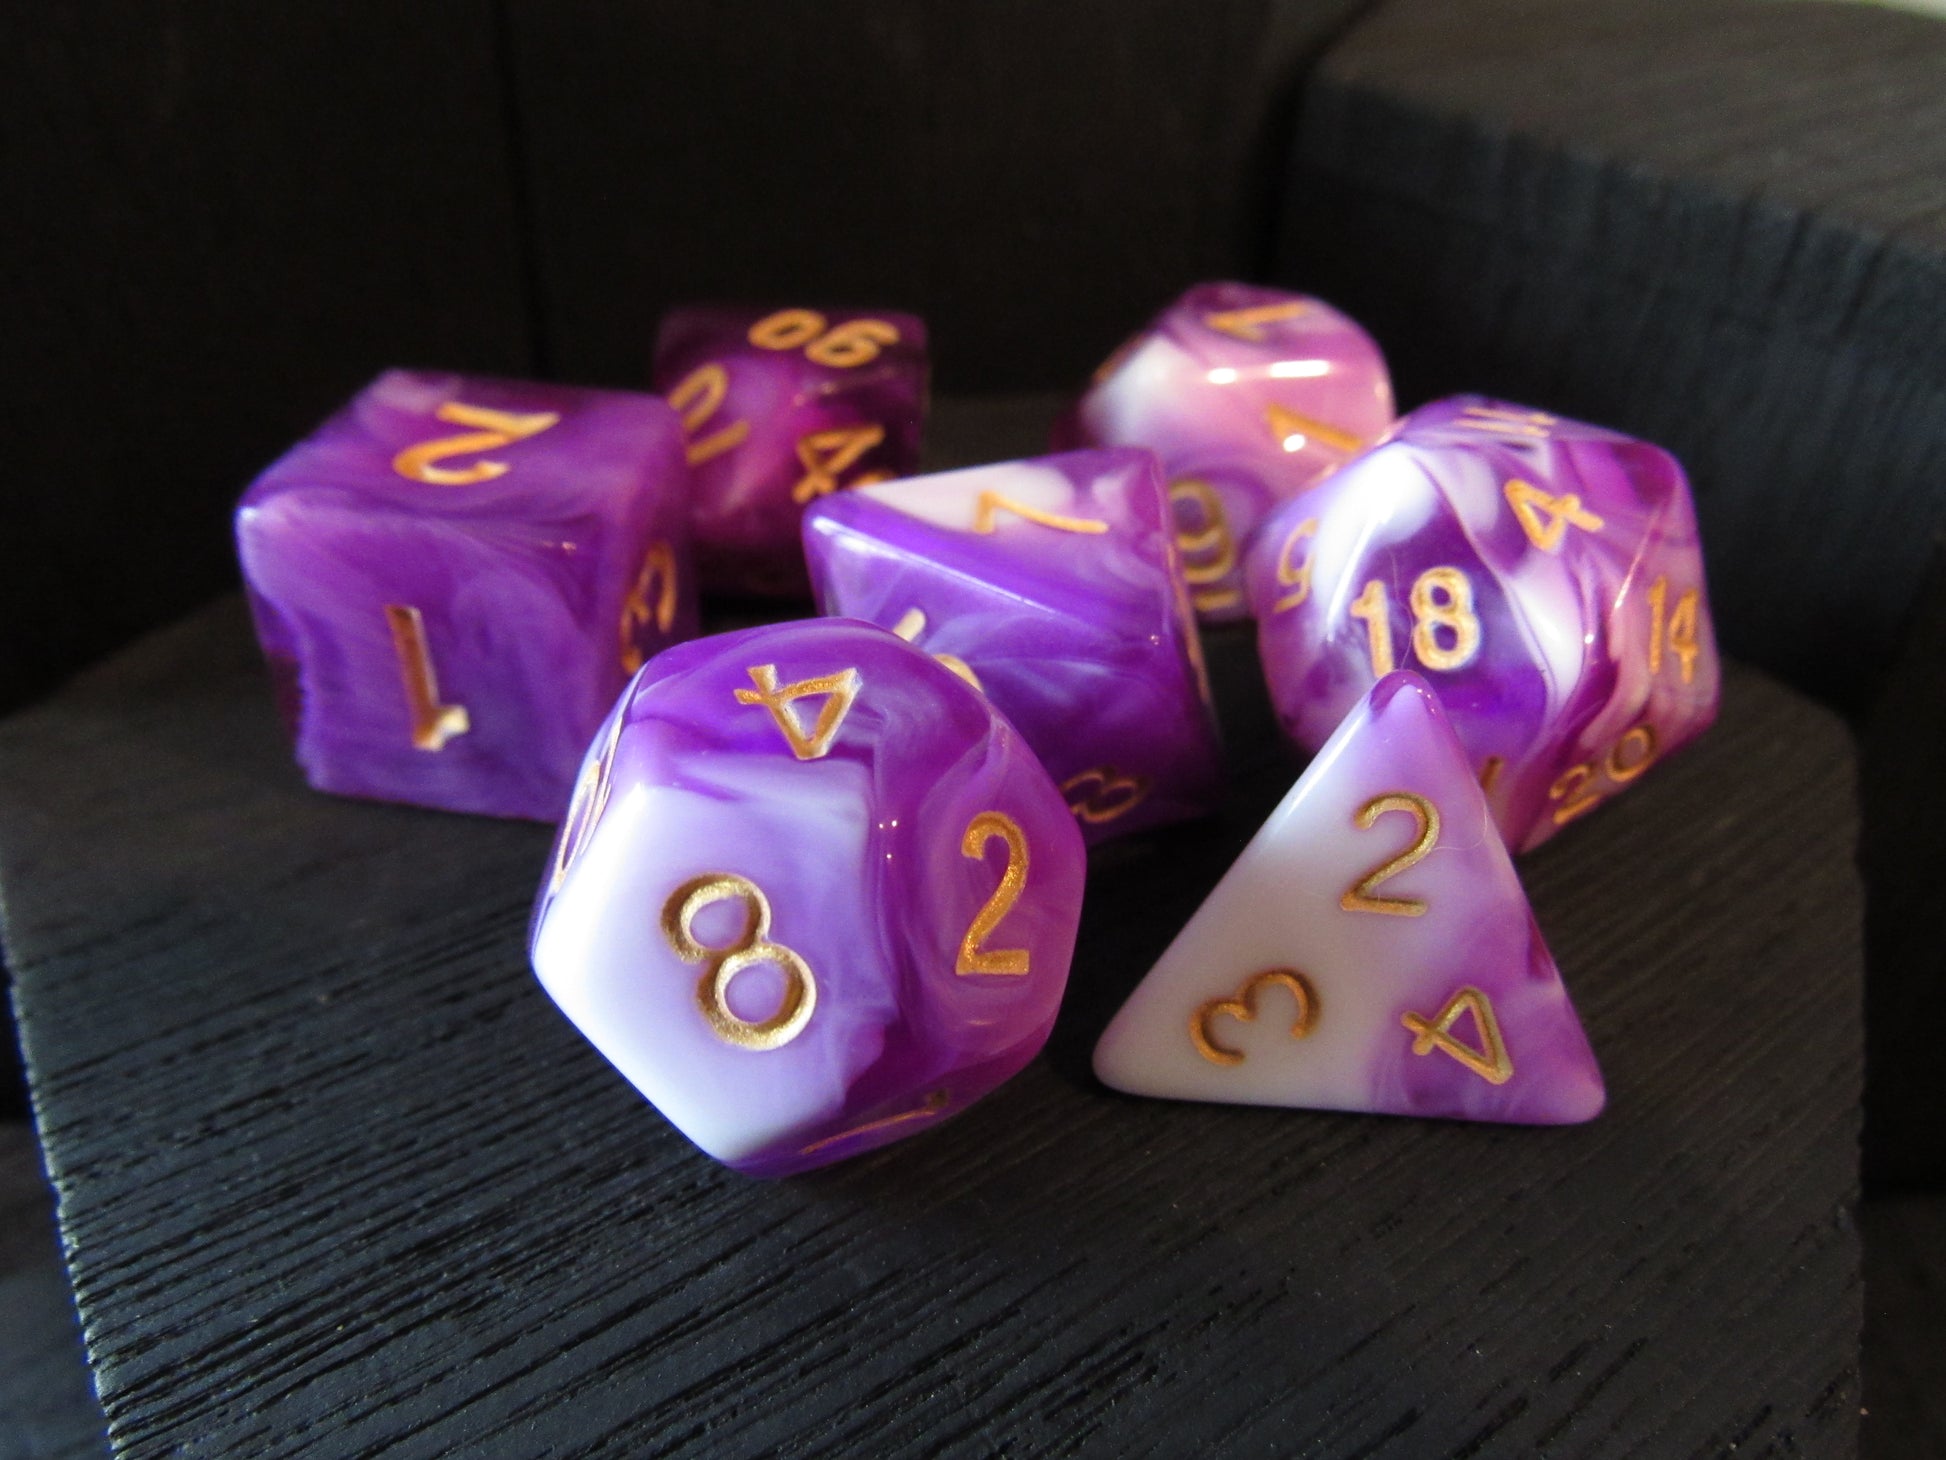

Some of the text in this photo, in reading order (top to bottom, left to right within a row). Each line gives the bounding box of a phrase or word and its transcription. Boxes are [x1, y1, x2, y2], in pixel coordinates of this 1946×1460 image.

[393, 402, 561, 486] 2
[973, 490, 1108, 533] 7
[1504, 479, 1604, 552] 4
[617, 542, 677, 676] 3
[1350, 565, 1481, 678] 18
[1647, 575, 1699, 685] 14
[384, 604, 470, 752] 1
[734, 664, 863, 760] 4
[1550, 724, 1658, 825] 20
[955, 811, 1030, 976] 2
[1341, 792, 1440, 917] 2
[660, 872, 817, 1052] 8
[1189, 968, 1322, 1066] 3
[1401, 985, 1514, 1085] 4
